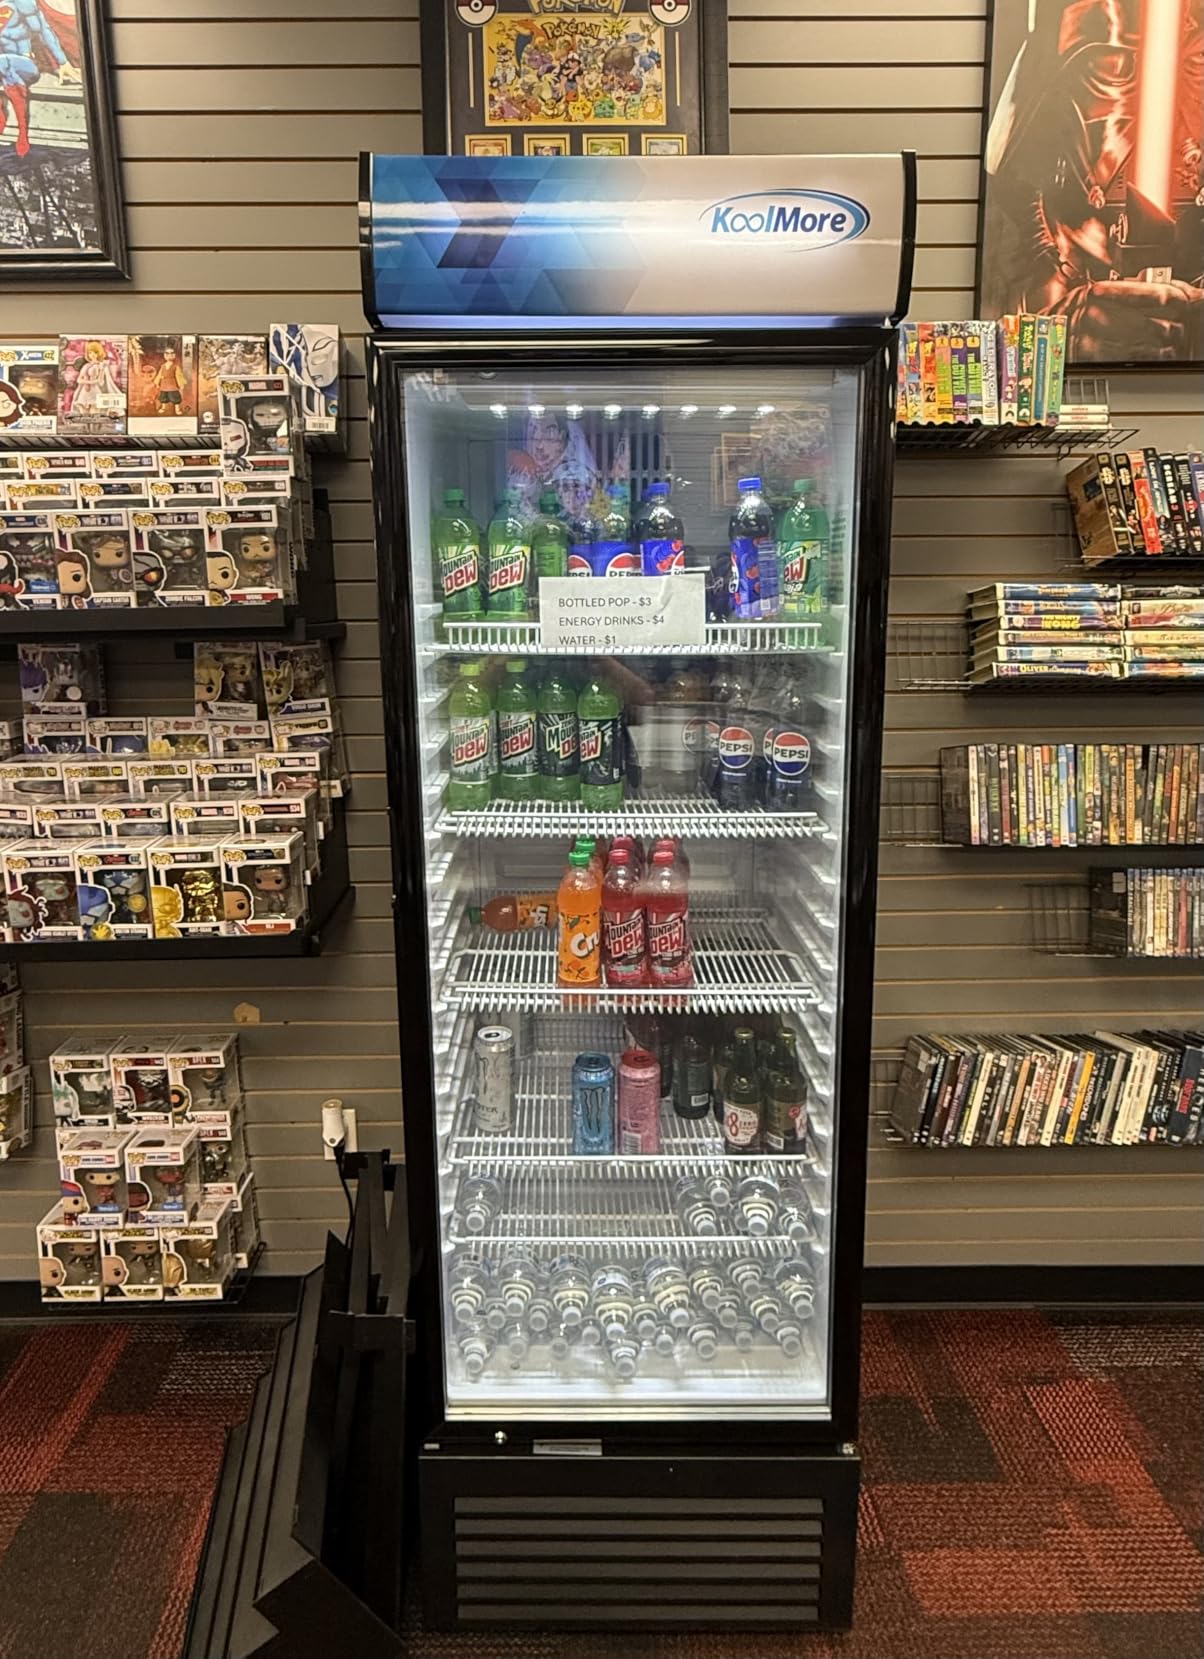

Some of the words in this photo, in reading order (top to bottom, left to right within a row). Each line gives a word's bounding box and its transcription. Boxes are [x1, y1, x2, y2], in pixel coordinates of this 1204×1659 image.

[711, 206, 847, 233] KoolMore
[558, 597, 606, 608] BOTTLED
[608, 598, 630, 607] POP
[638, 597, 652, 607] $3
[559, 617, 602, 627] ENERGY
[604, 616, 644, 626] DRINKS
[653, 615, 665, 625] $4
[559, 636, 596, 645] WATER
[604, 635, 616, 645] $1
[720, 743, 752, 753] PEPSI
[774, 748, 809, 759] PEPSI
